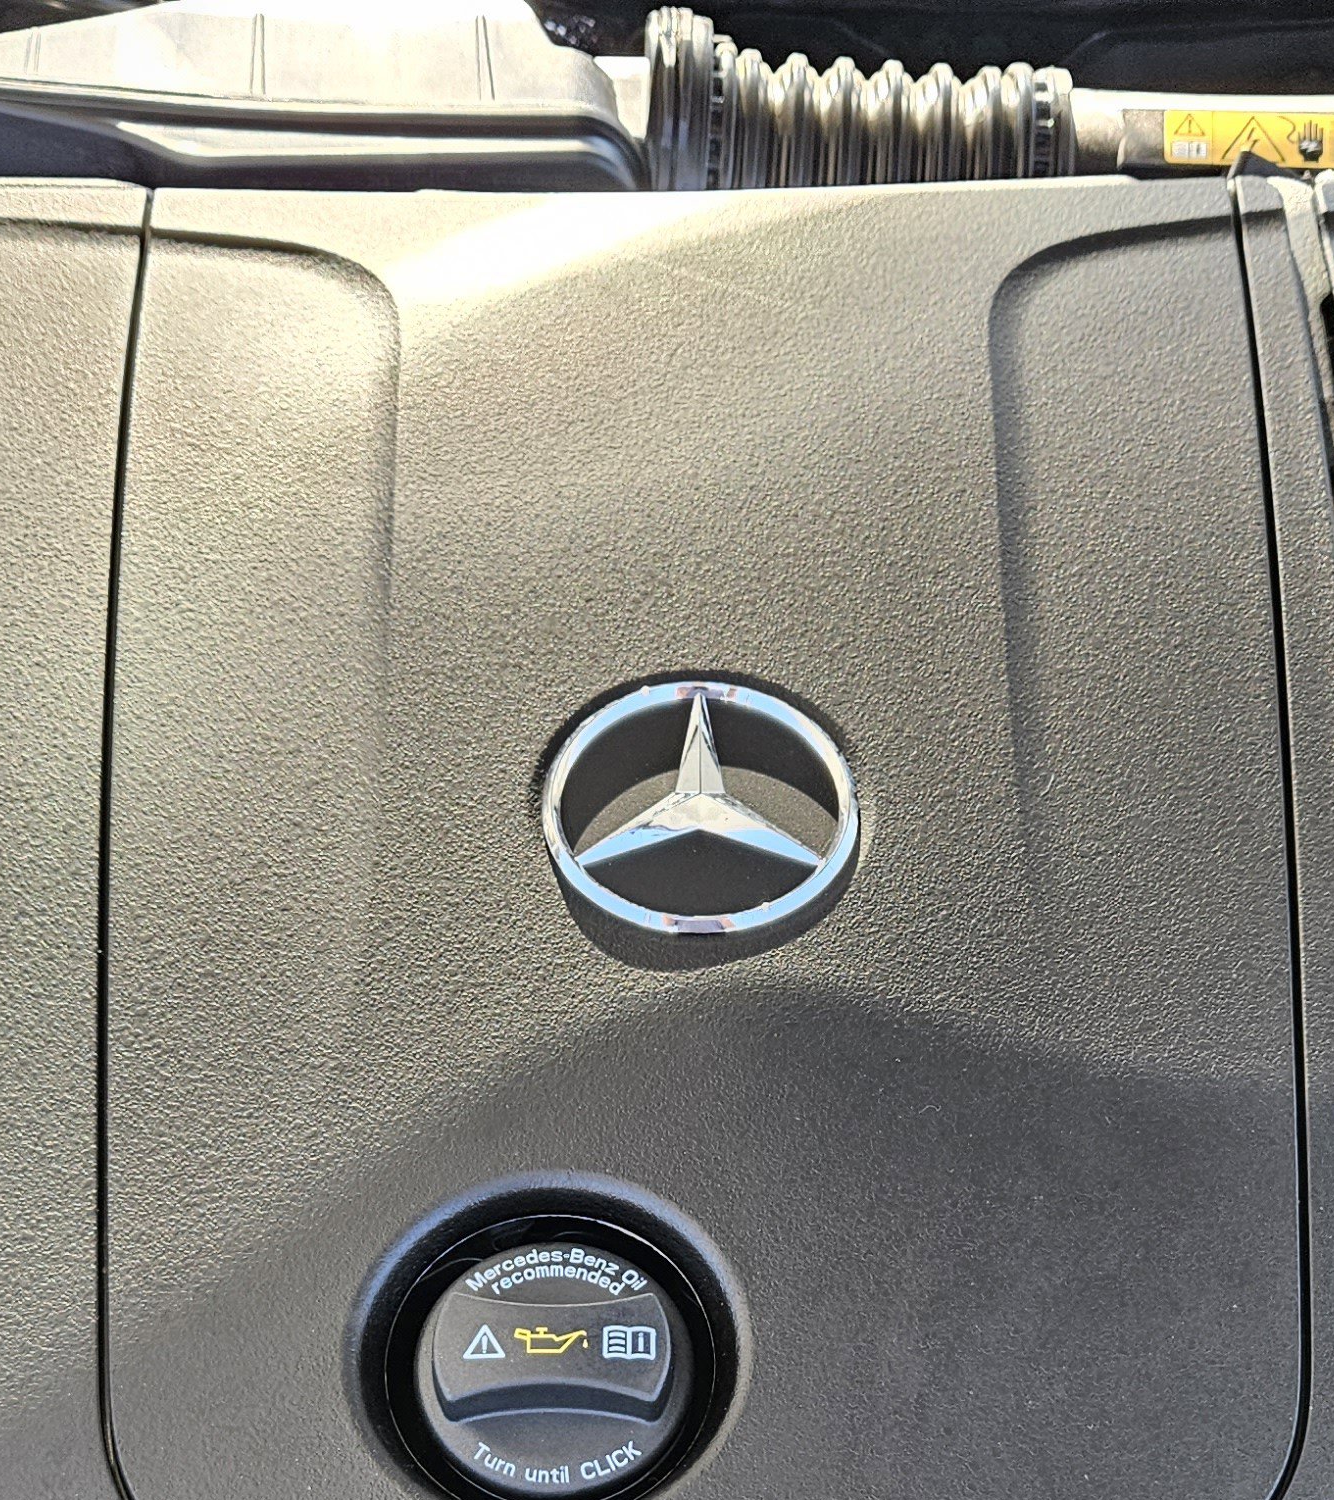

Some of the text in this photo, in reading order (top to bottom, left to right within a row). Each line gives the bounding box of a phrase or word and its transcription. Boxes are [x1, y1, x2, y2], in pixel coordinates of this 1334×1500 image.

[465, 1247, 649, 1292] Mercedes-Benz Oil
[490, 1264, 626, 1296] recommended
[473, 1440, 643, 1484] Turn until CLICK
